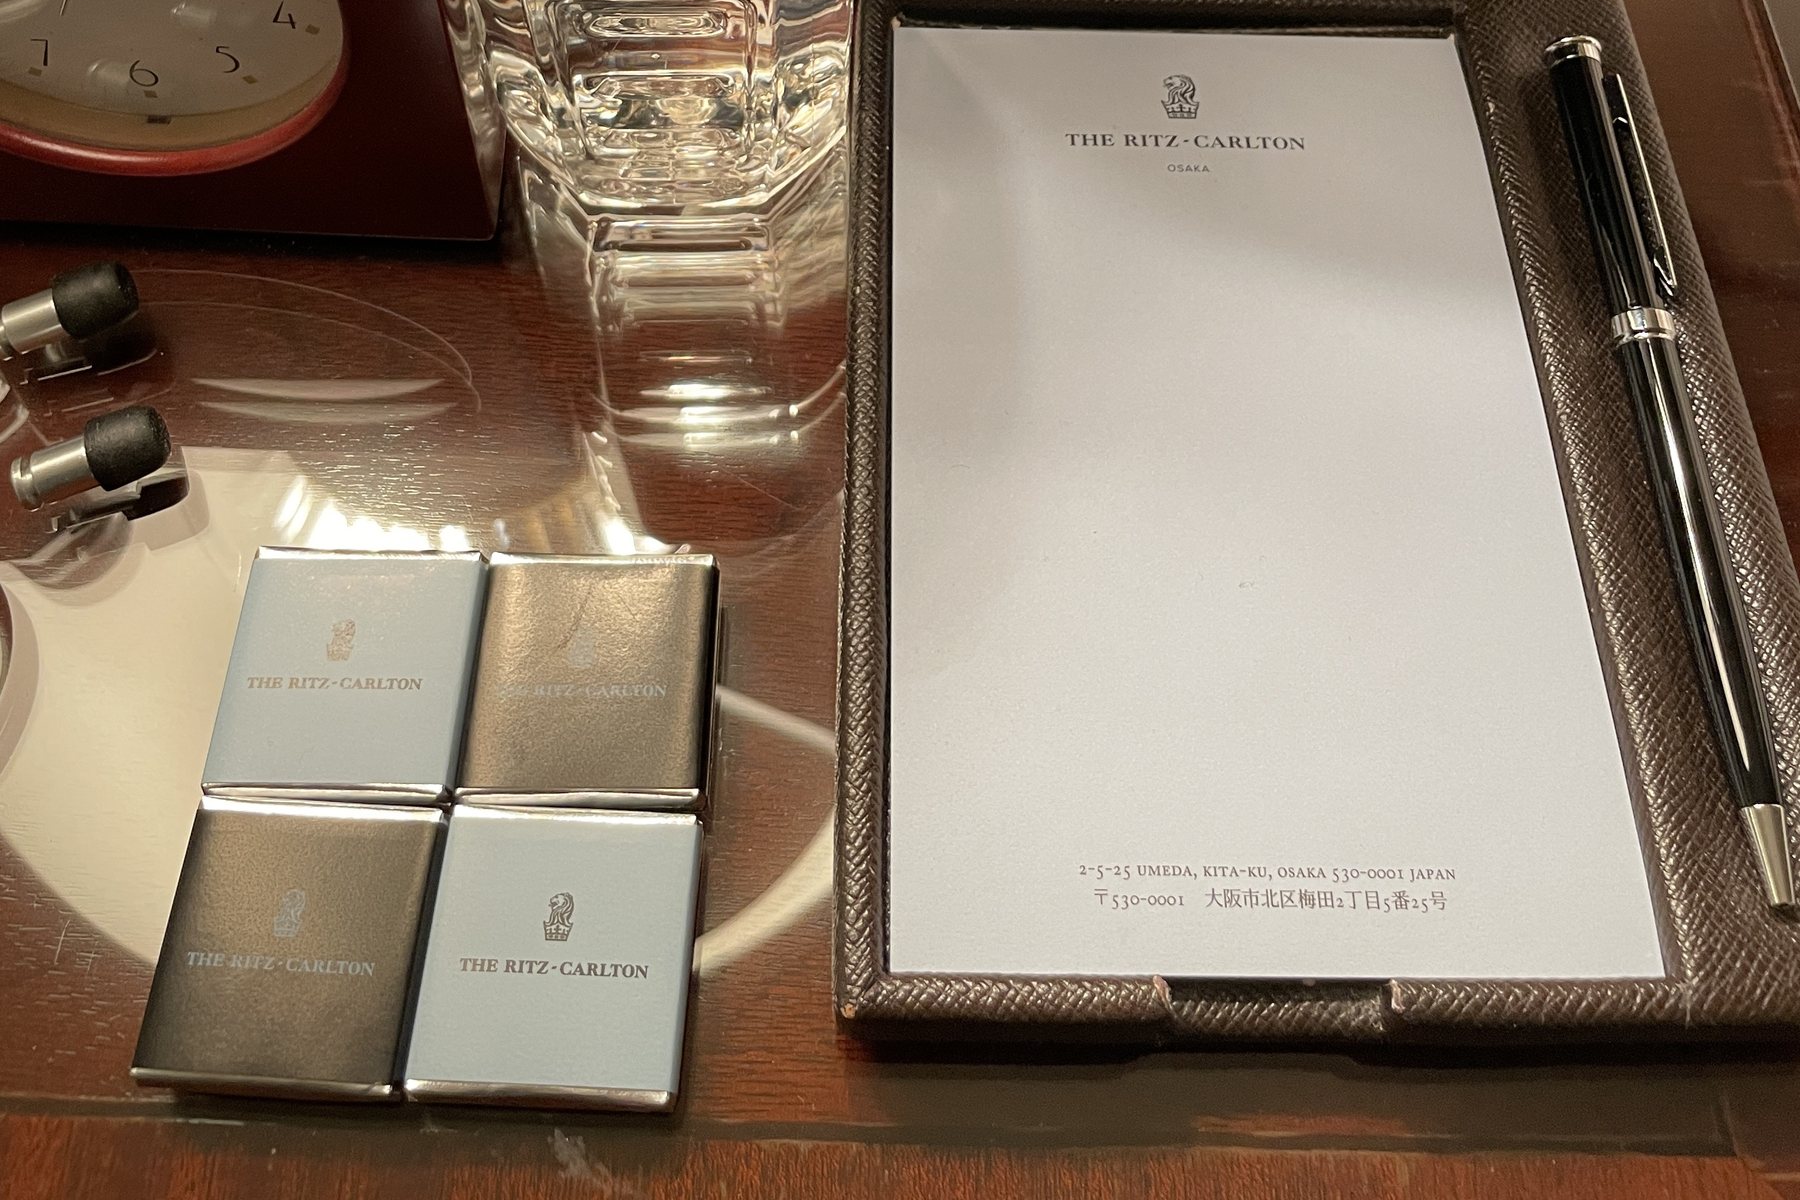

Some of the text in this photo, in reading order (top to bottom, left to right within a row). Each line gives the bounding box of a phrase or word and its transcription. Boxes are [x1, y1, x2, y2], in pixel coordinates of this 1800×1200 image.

[272, 1, 296, 29] 4
[30, 38, 48, 66] 7
[215, 46, 240, 73] 5
[129, 60, 159, 87] 6
[1065, 133, 1305, 150] THE RITZ-CARLTON
[1167, 163, 1210, 173] OSAKA
[247, 677, 423, 690] THE RITZ-CARLTON
[1079, 865, 1456, 883] 2-5-25 UMEDA, KITA-KU, OSAKA 530-0001 JAPAN
[1204, 887, 1448, 913] 大阪市北区梅田2丁目5番25号
[187, 951, 225, 967] THE
[460, 958, 649, 979] THE RITZ-CARLTON
